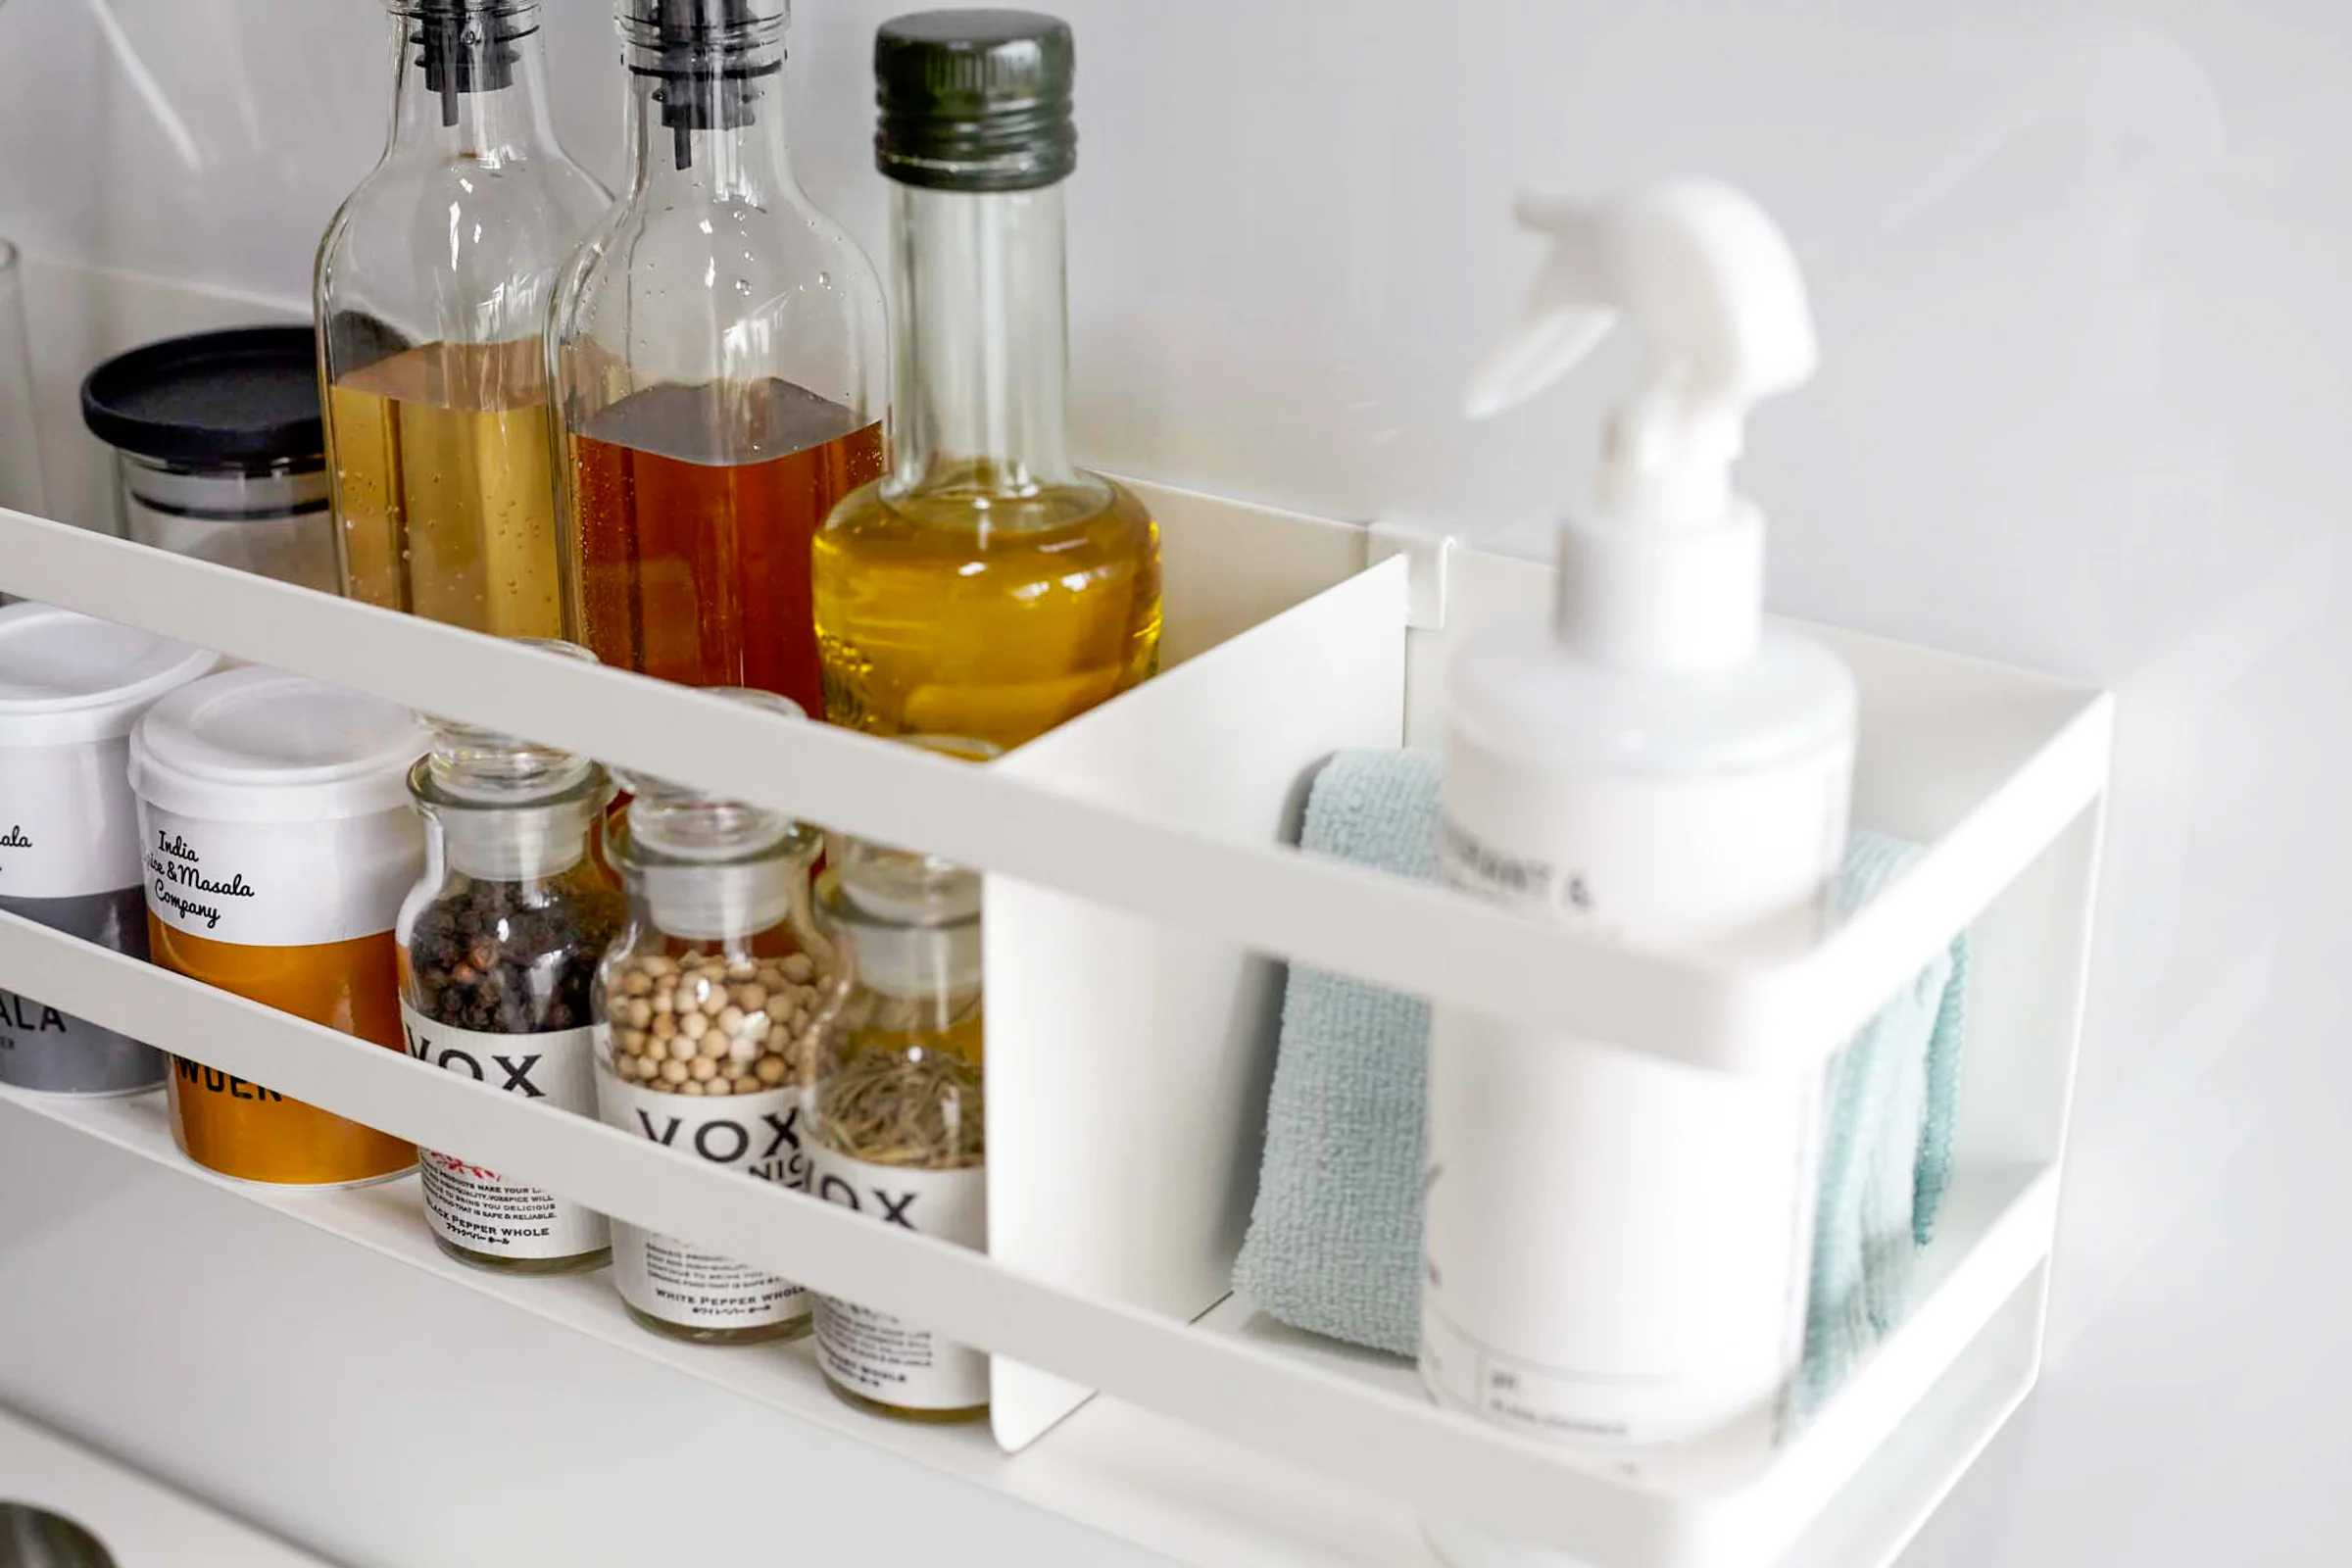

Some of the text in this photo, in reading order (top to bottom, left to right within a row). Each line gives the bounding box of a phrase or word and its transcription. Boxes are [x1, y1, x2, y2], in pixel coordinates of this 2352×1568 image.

[158, 829, 199, 862] India
[155, 877, 221, 929] Company
[635, 1106, 800, 1163] VOX
[503, 1202, 557, 1211] DELICIOUS
[451, 1214, 498, 1236] PEPPER
[501, 1226, 551, 1237] WHOLE
[656, 1287, 697, 1305] WHITE
[700, 1296, 757, 1306] PEPPER
